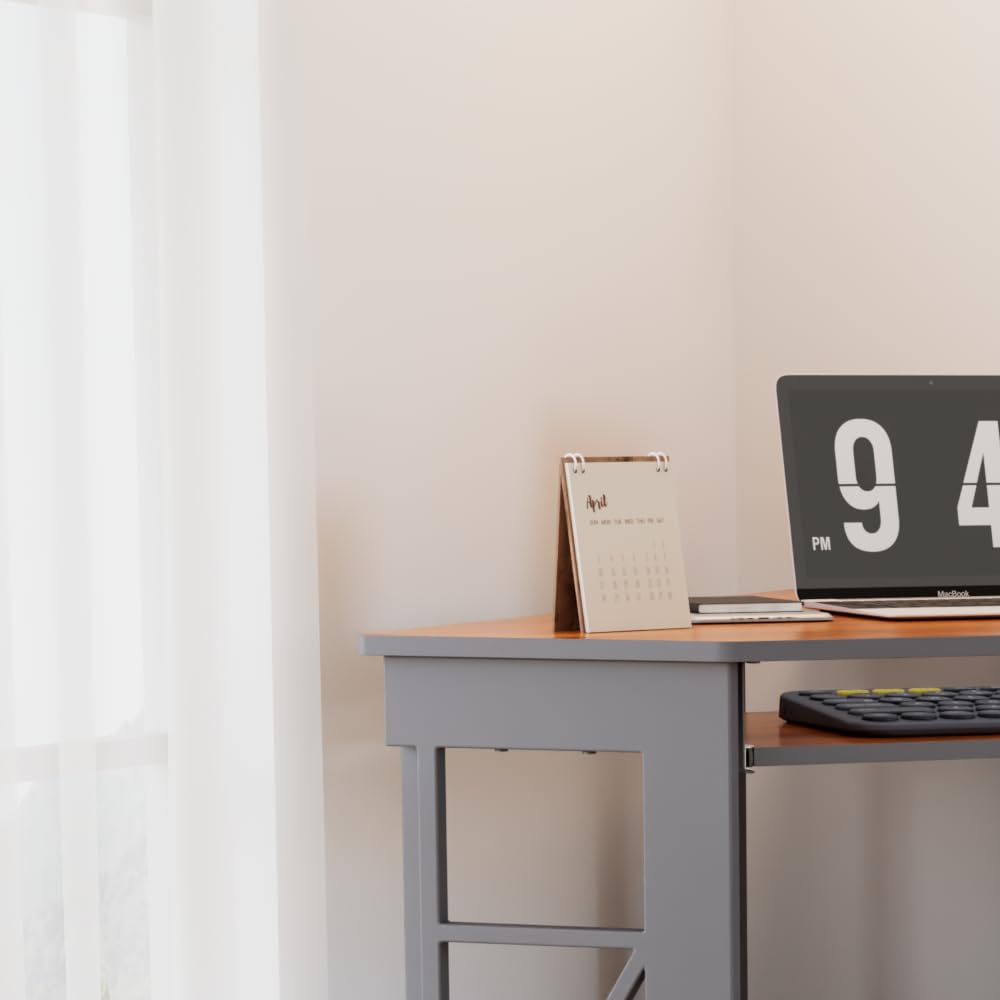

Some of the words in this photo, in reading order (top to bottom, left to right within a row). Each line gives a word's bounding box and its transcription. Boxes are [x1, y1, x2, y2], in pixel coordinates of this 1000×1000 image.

[834, 417, 900, 553] 9
[587, 494, 608, 512] April
[811, 536, 831, 551] PM
[937, 590, 970, 598] MacBook
